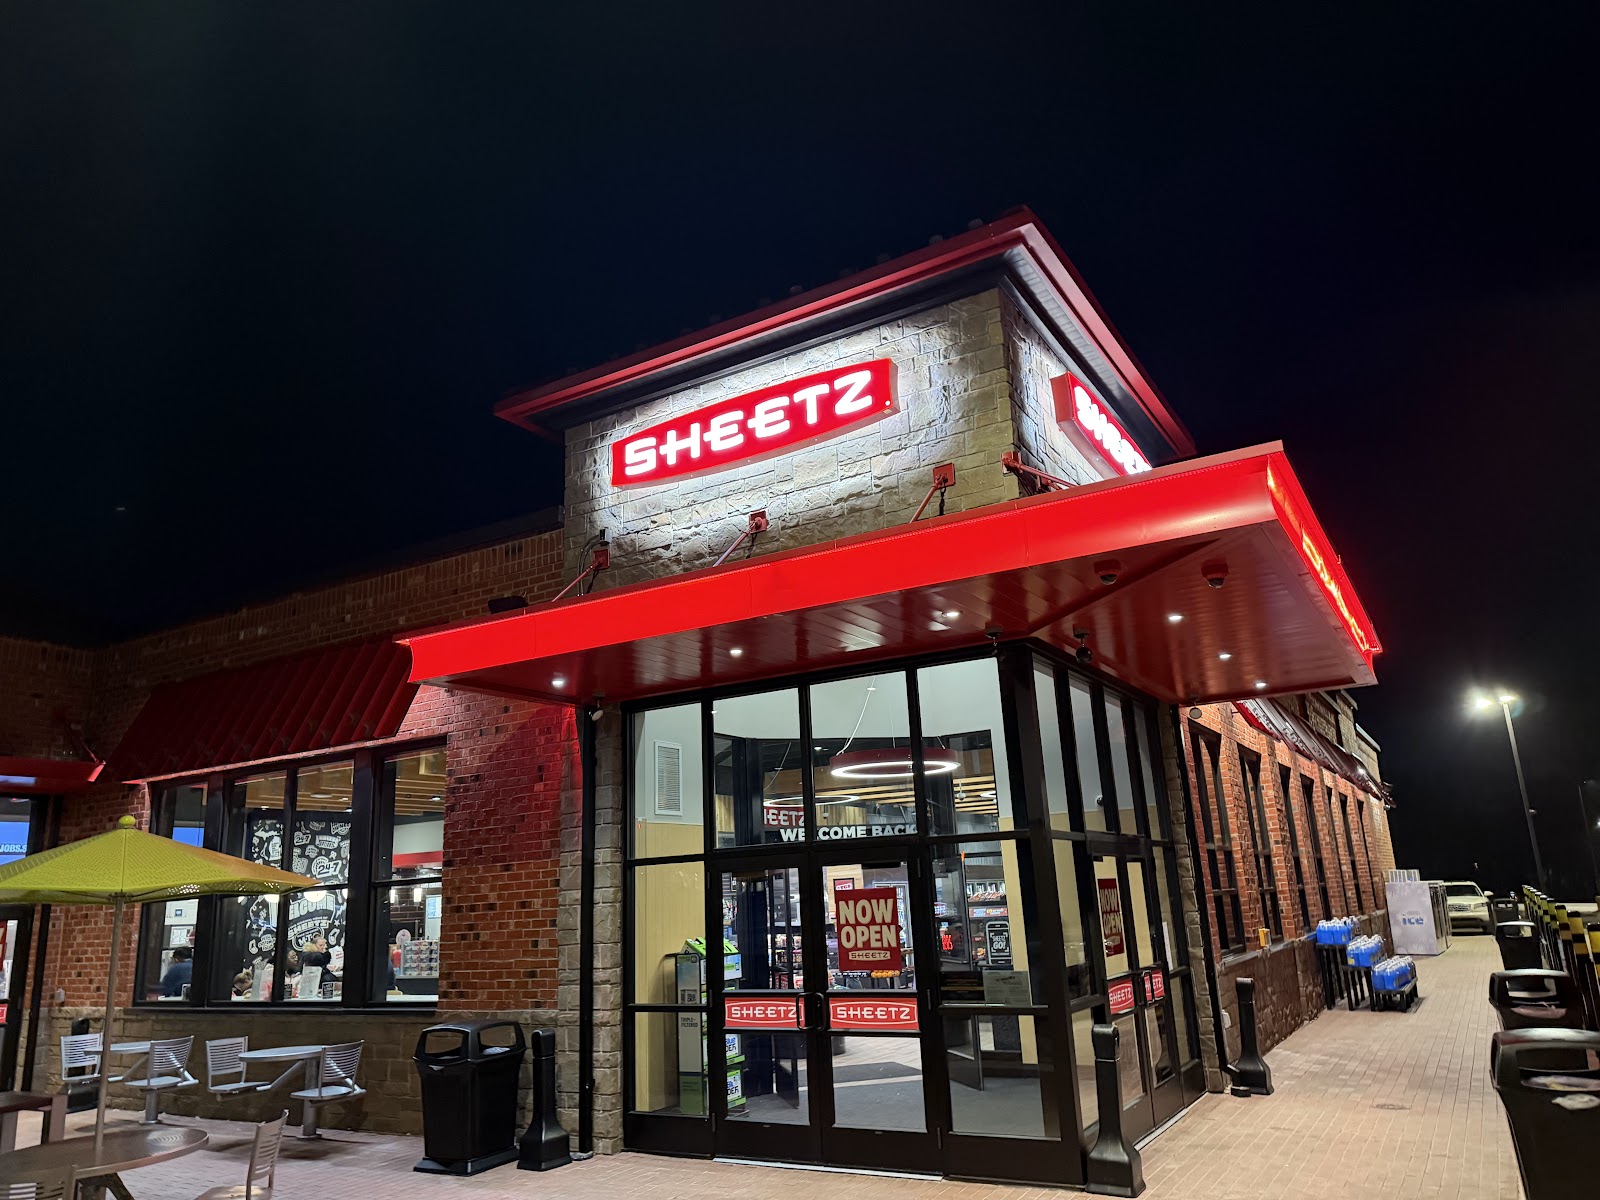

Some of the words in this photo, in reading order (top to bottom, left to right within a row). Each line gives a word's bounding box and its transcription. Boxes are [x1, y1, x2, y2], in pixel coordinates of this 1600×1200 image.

[624, 369, 873, 476] SHEETZ
[763, 808, 804, 826] EETZ
[780, 825, 867, 842] WECOME
[1099, 888, 1119, 912] NOW
[838, 898, 894, 925] NOW
[840, 925, 898, 949] OPEN
[993, 941, 1006, 949] GO!
[1109, 989, 1132, 1005] SHEETZ
[731, 1006, 797, 1018] SHEETZ
[836, 1007, 911, 1020] SHEETZ
